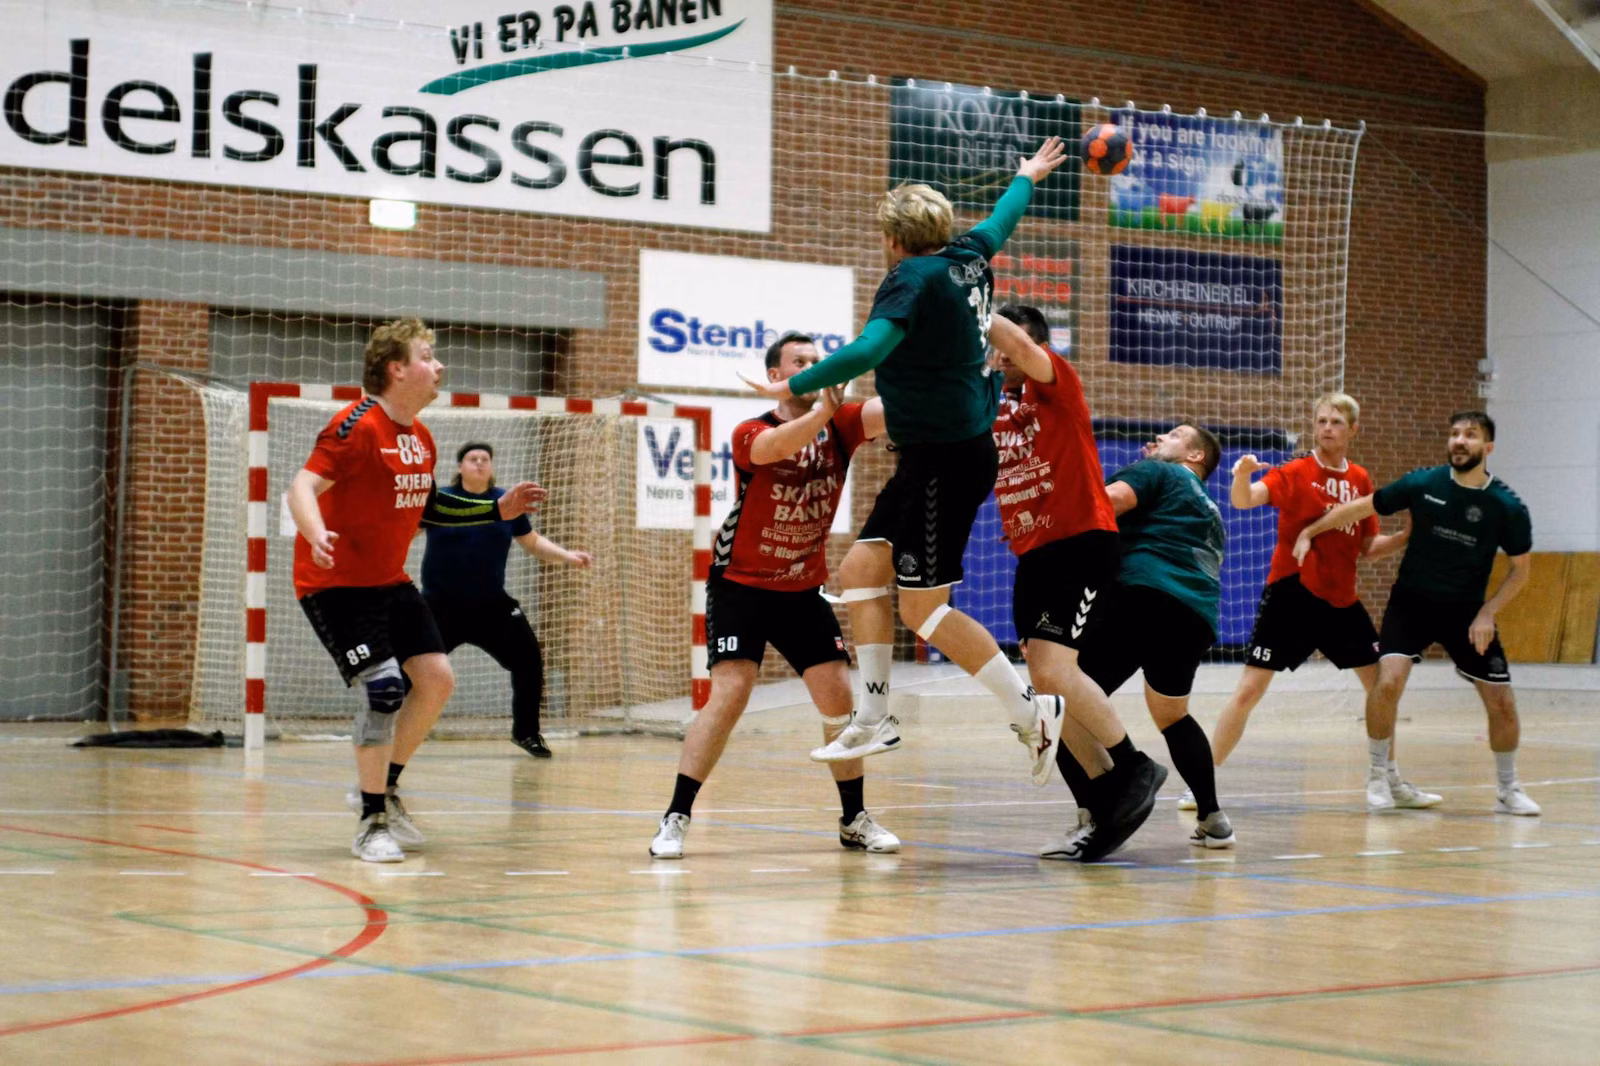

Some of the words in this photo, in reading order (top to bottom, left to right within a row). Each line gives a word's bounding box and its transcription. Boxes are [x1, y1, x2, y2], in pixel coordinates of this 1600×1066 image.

[450, 22, 483, 65] VI
[497, 11, 542, 52] ER
[4, 38, 717, 205] delskassen
[935, 94, 1038, 144] ROYAL
[1138, 121, 1173, 144] you
[1177, 126, 1207, 146] are
[1152, 152, 1164, 168] a
[1168, 147, 1207, 177] sign
[395, 432, 425, 466] 89
[773, 498, 832, 524] BANK
[346, 643, 371, 666] 89
[717, 635, 739, 653] 50
[1252, 645, 1273, 662] 45
